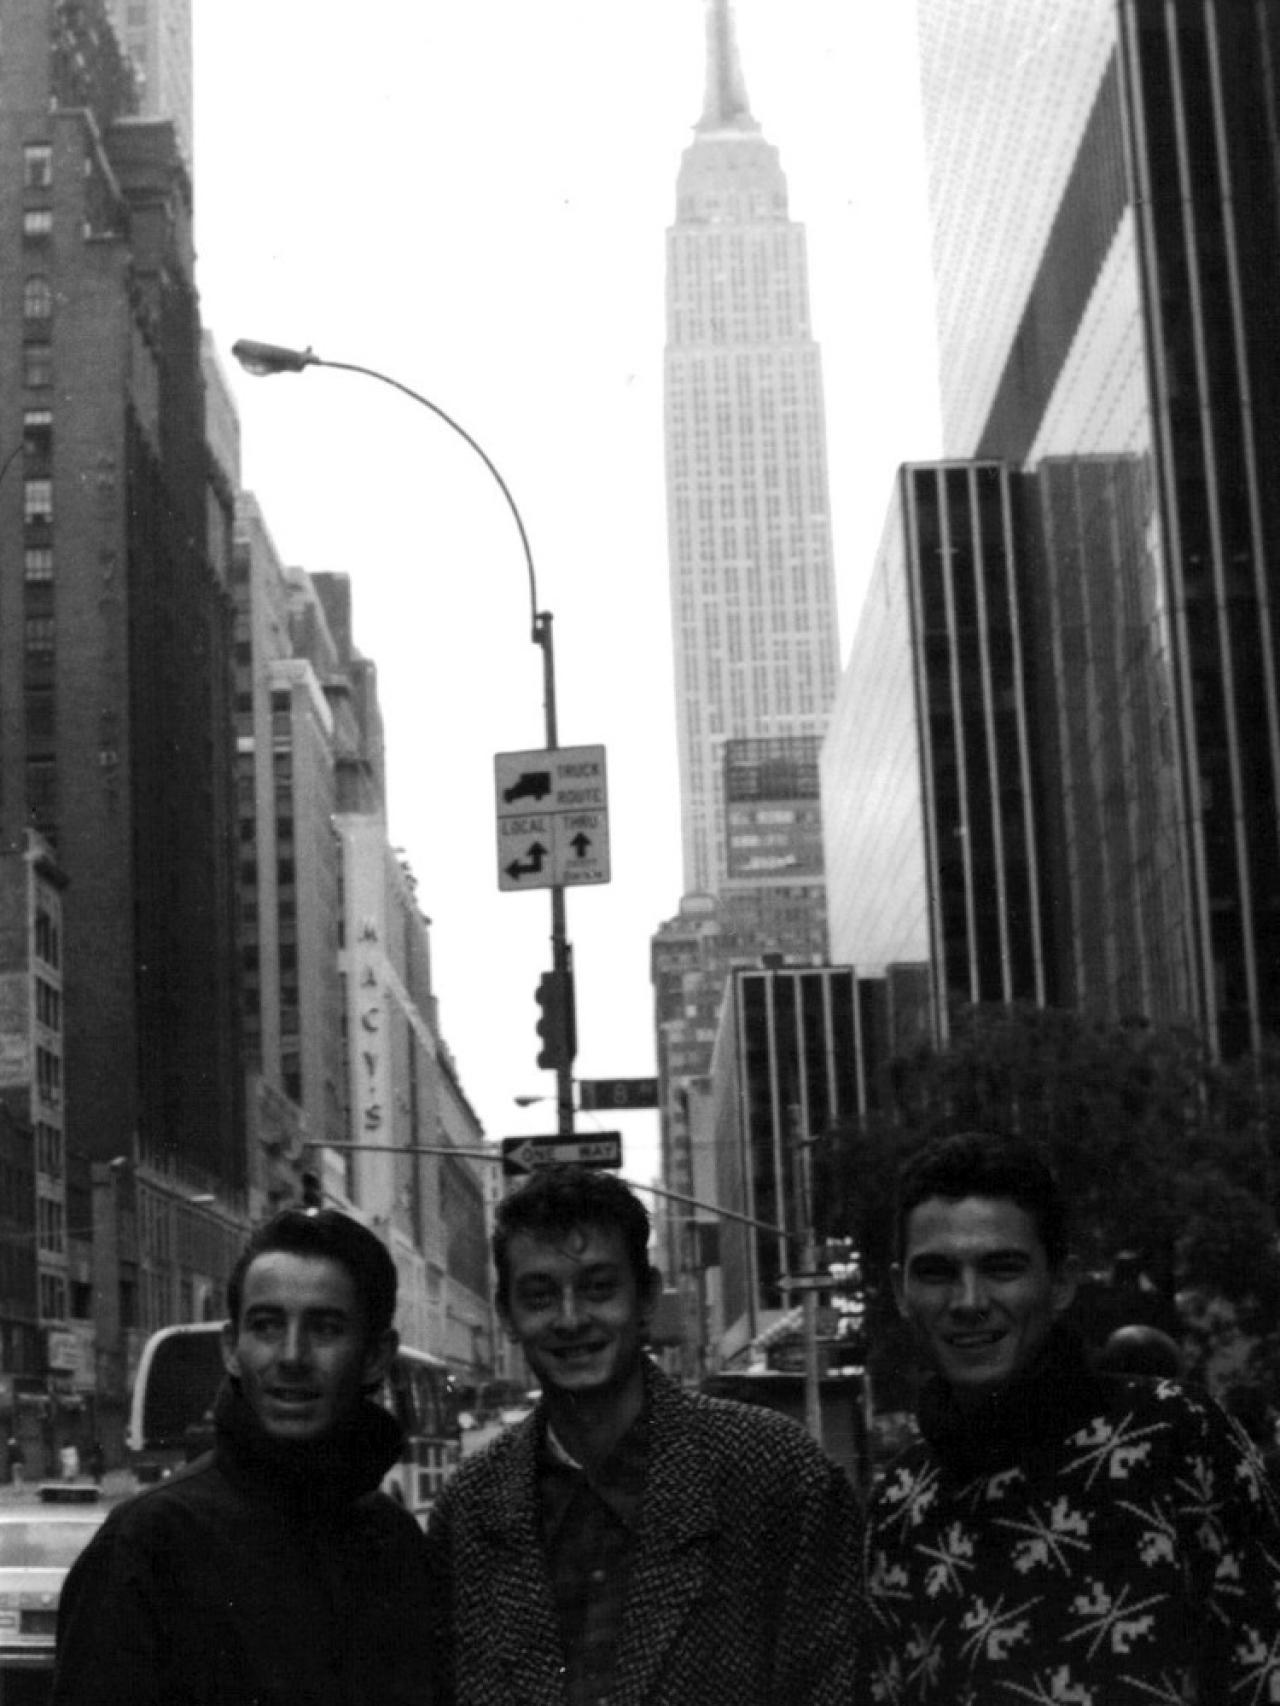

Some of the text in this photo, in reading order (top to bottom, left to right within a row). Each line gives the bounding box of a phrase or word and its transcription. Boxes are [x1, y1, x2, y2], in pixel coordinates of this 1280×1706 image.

[557, 763, 599, 778] TRUCK
[557, 788, 601, 804] ROUTE
[502, 818, 546, 835] LOCAL
[521, 1143, 613, 1163] ONE WAY
